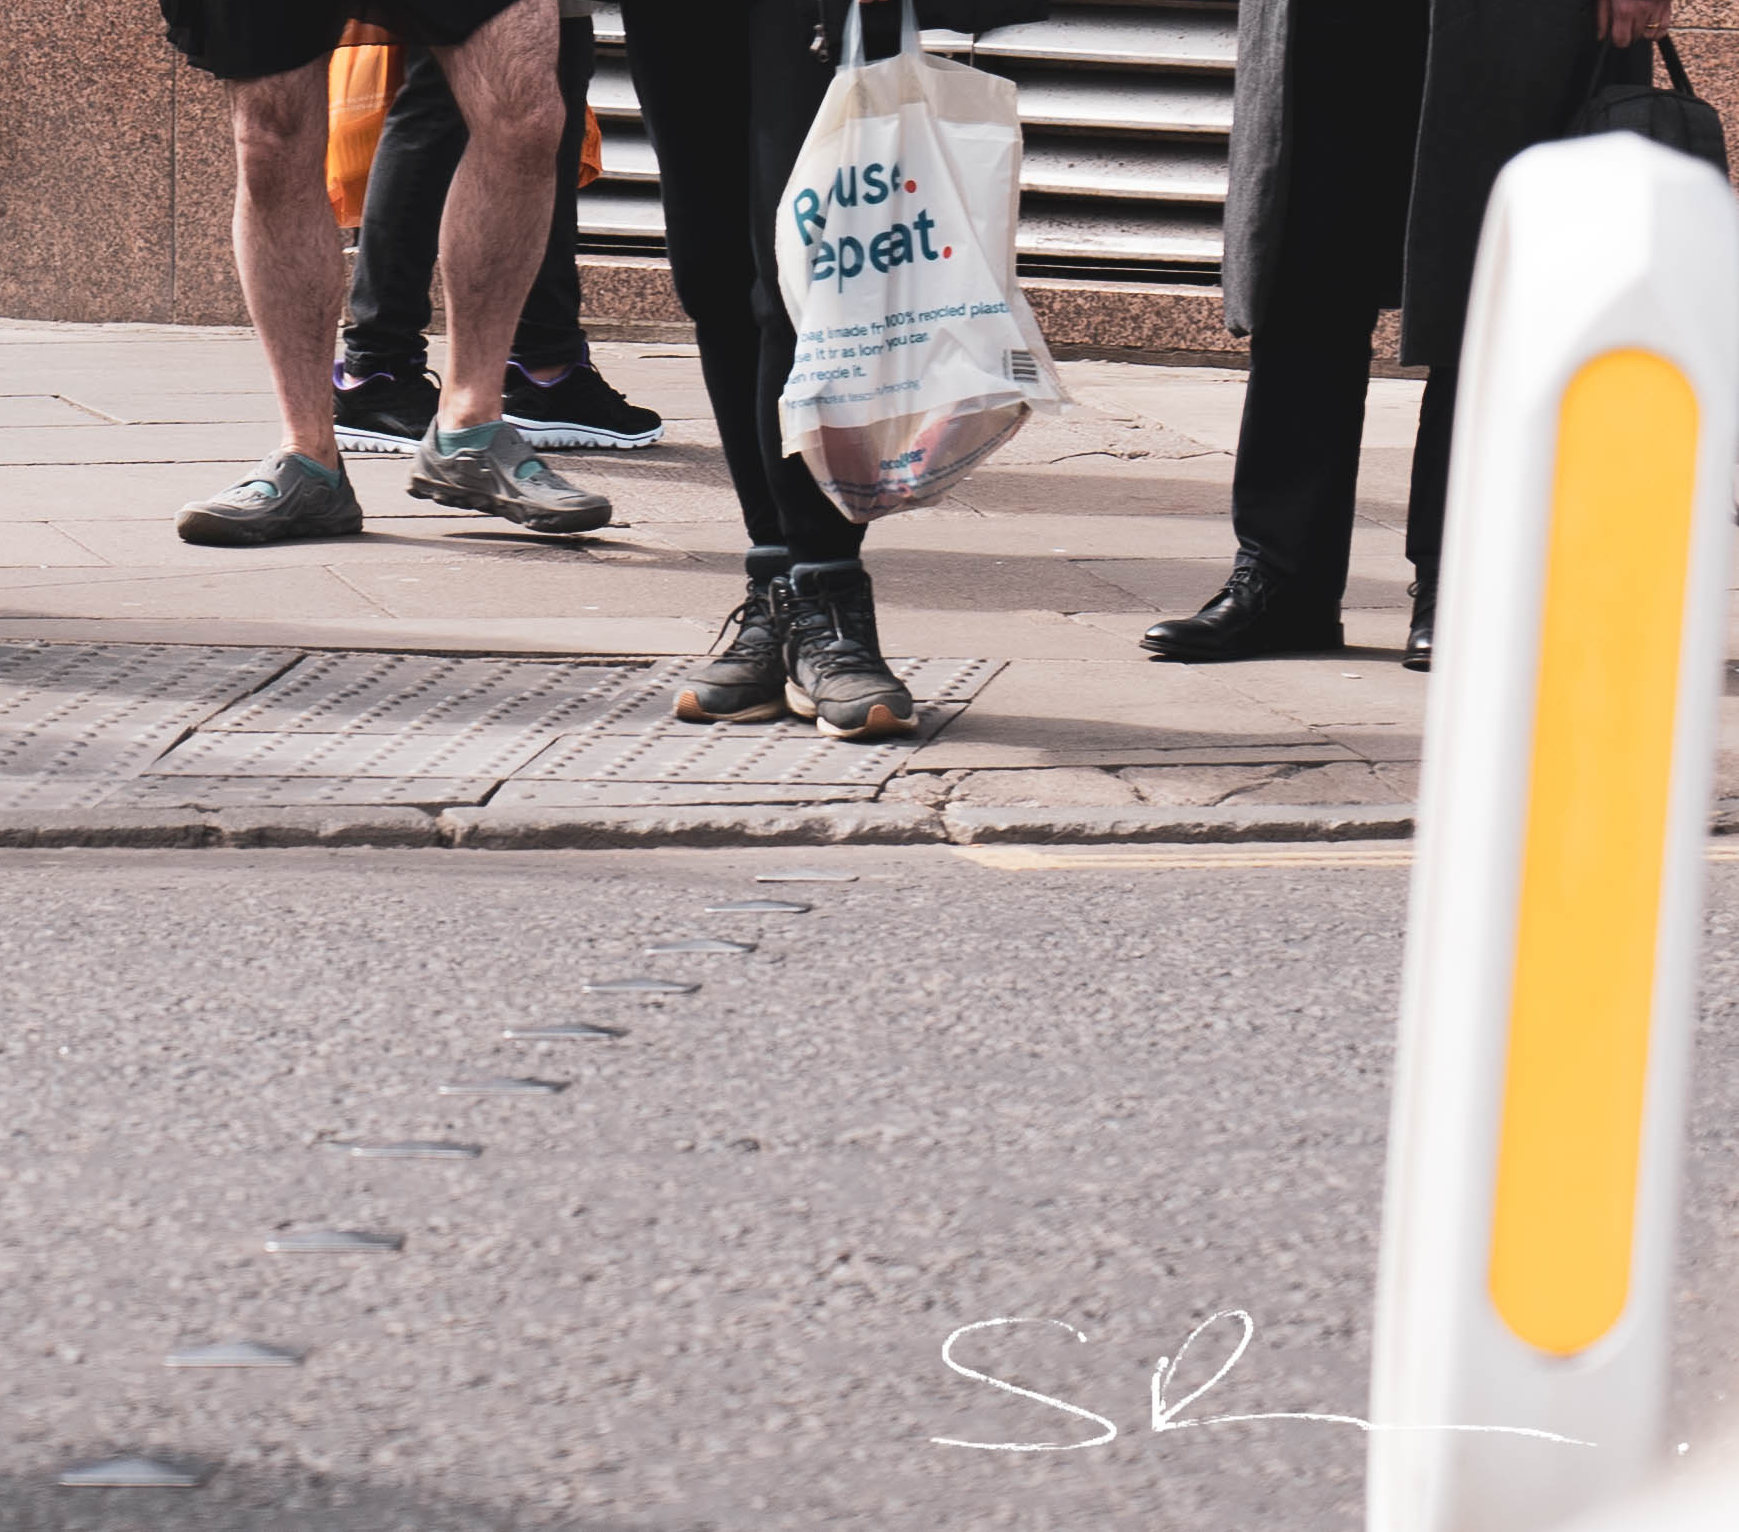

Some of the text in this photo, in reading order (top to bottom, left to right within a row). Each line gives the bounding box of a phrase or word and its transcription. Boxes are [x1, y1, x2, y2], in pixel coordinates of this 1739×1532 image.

[793, 160, 918, 247] Ruse.
[811, 209, 953, 294] epeat.
[885, 311, 916, 329] 100%
